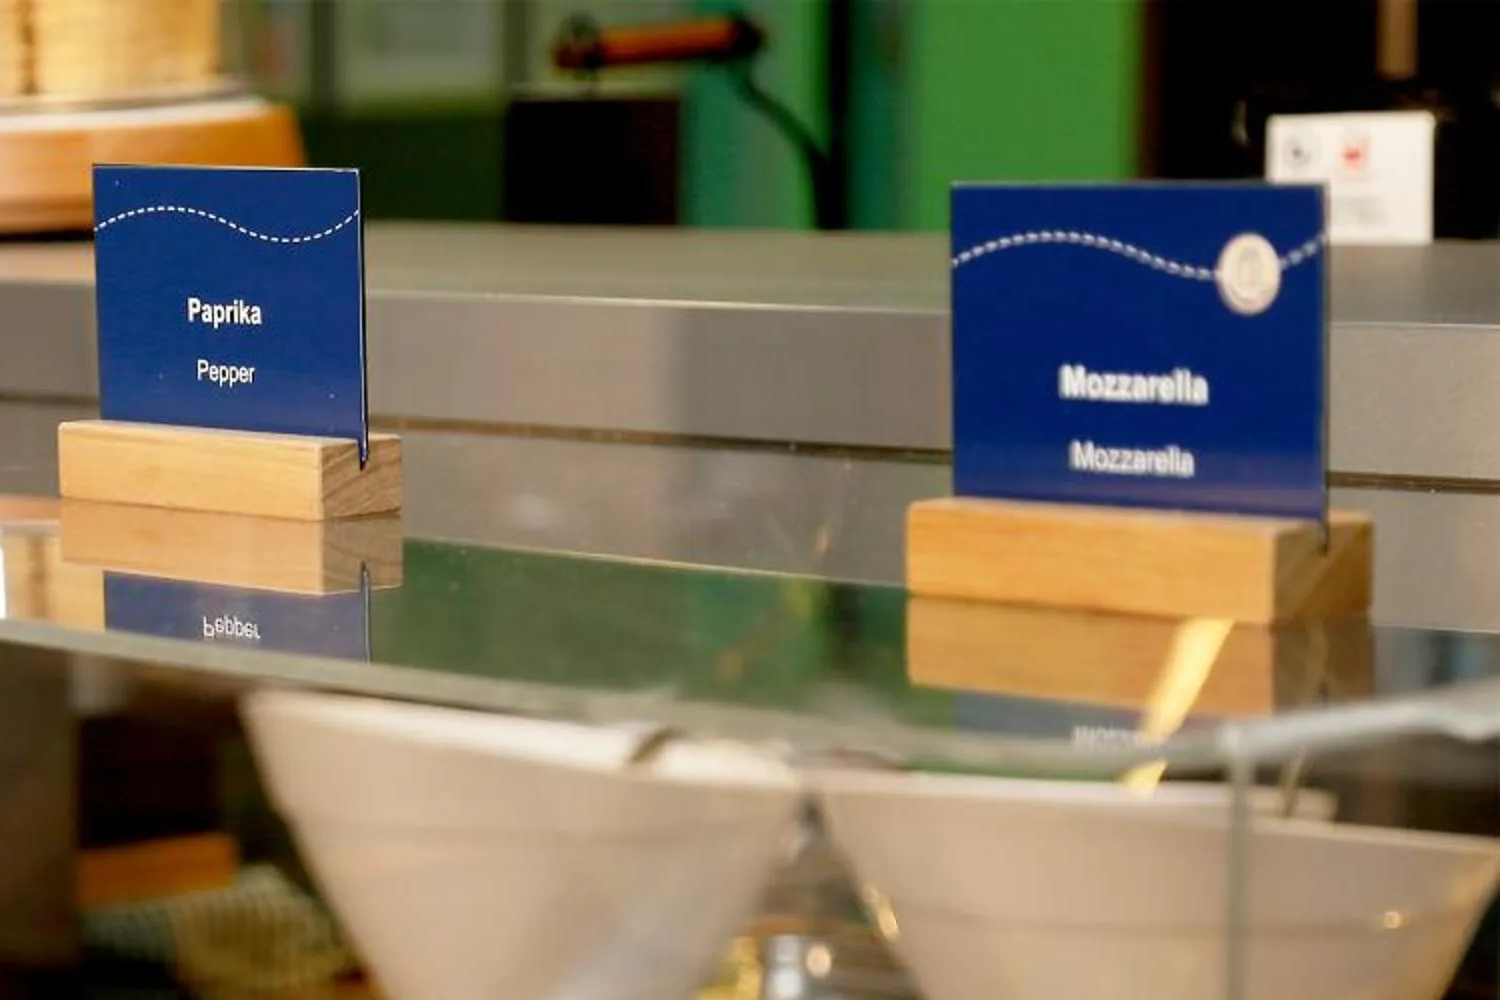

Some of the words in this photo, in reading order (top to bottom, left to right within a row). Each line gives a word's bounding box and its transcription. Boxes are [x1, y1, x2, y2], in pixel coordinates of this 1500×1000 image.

[187, 297, 262, 329] Paprika
[197, 359, 256, 388] Pepper
[1059, 364, 1209, 405] Mozzarella
[1070, 440, 1196, 477] Mozzarella
